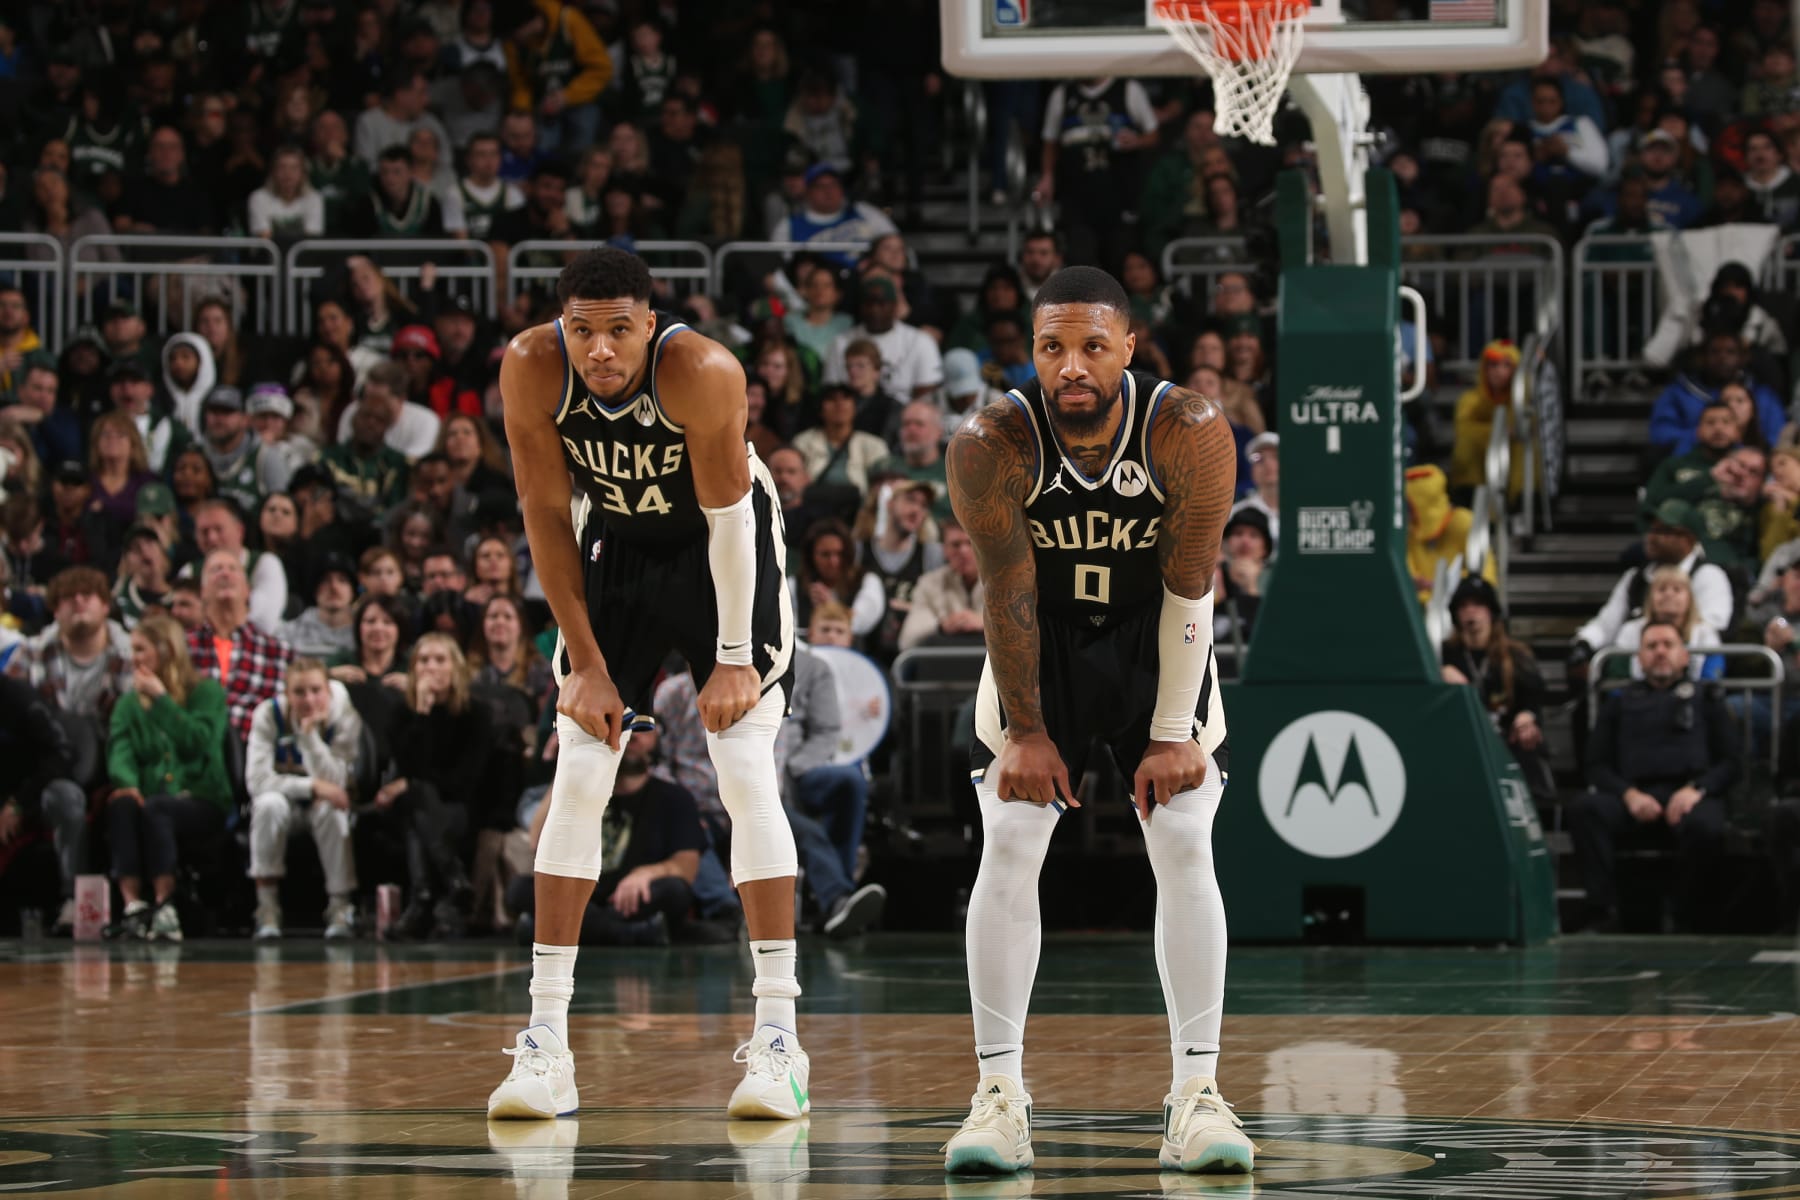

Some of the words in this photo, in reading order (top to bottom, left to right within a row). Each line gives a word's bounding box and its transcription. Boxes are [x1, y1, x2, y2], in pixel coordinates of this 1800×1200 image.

[1290, 402, 1379, 424] ULTRA
[562, 436, 684, 480] BUCKS
[593, 476, 673, 516] 34
[1030, 510, 1161, 551] BUCKS
[1298, 511, 1349, 528] BUCKS
[1298, 530, 1331, 548] PRO
[1332, 530, 1375, 548] SHOP
[1075, 563, 1111, 604] 0
